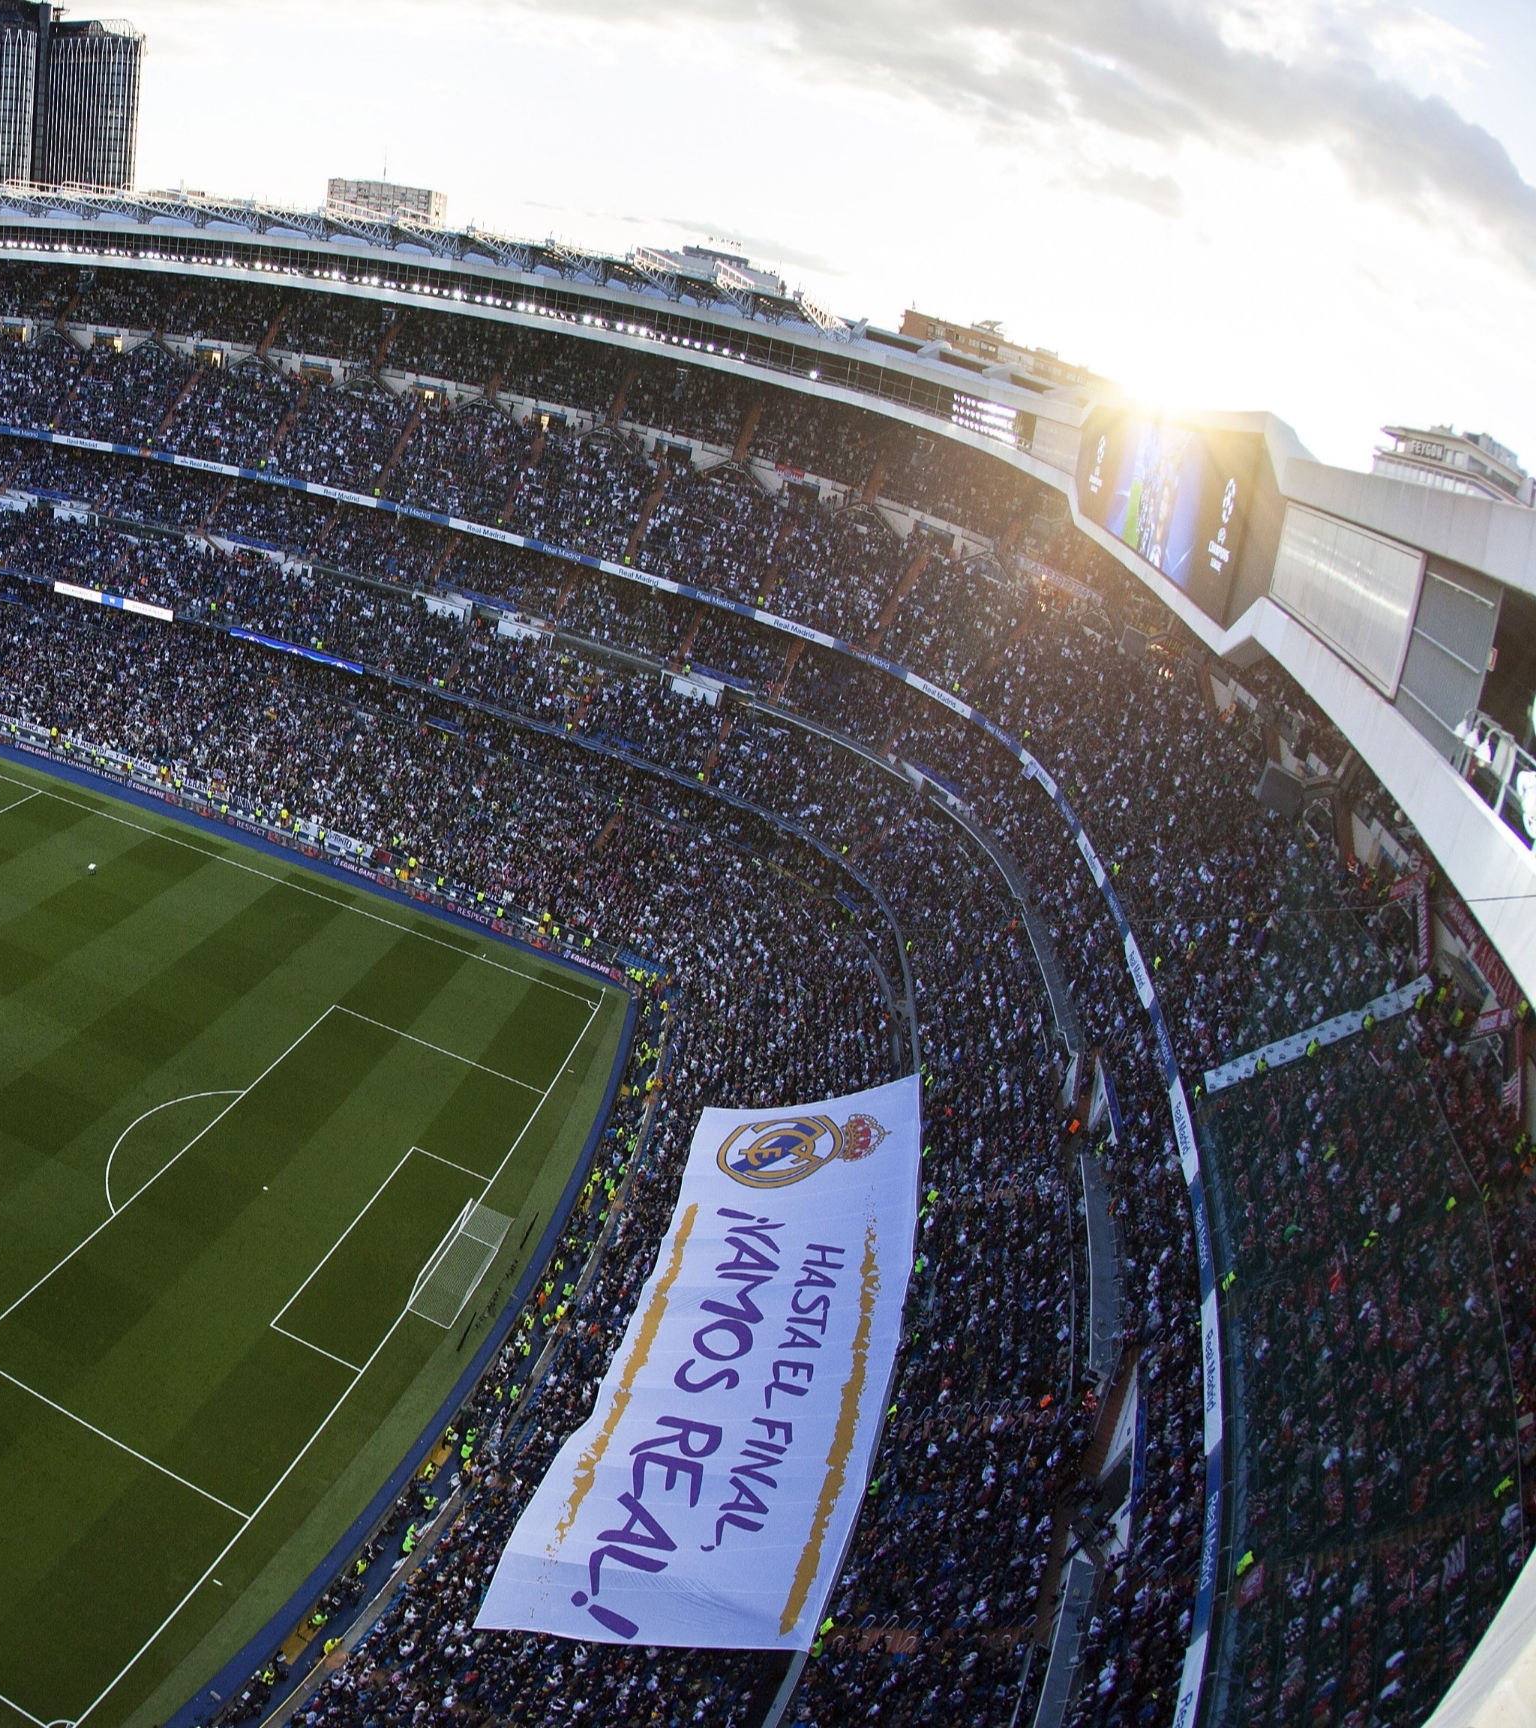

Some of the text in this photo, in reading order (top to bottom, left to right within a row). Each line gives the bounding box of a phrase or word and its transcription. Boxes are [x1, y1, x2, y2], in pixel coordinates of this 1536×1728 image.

[79, 440, 98, 448] Madrid
[189, 460, 224, 472] Real Madrid
[256, 473, 290, 486] Real Madrid
[324, 488, 360, 502] Real Madrid
[395, 504, 431, 520] Real Madrid
[466, 524, 506, 540] Real Madrid
[542, 544, 580, 562] Real Madrid
[618, 568, 659, 586] Real Madrid
[696, 592, 736, 610] Real Madrid
[774, 618, 815, 639] Real Madrid
[867, 655, 890, 670] Madrid
[922, 684, 956, 708] Real Madrid
[984, 721, 1012, 746] Real Madrid
[52, 753, 123, 784] UEFA CHAMPIONS LEAGUE
[236, 820, 266, 836] RESPECT
[457, 906, 490, 925] RESPECT
[1128, 950, 1145, 990] Real Madrid
[1173, 1100, 1192, 1156] Real Madrid
[1194, 1203, 1209, 1269] Real Madrid
[783, 1242, 845, 1350] HASTA
[1204, 1328, 1216, 1413] Real Madrid
[764, 1360, 815, 1410] EL
[570, 1207, 786, 1641] ¡VAMOS REAL!
[1200, 1490, 1219, 1592] Real Madrid
[1174, 1690, 1193, 1728] Rea
